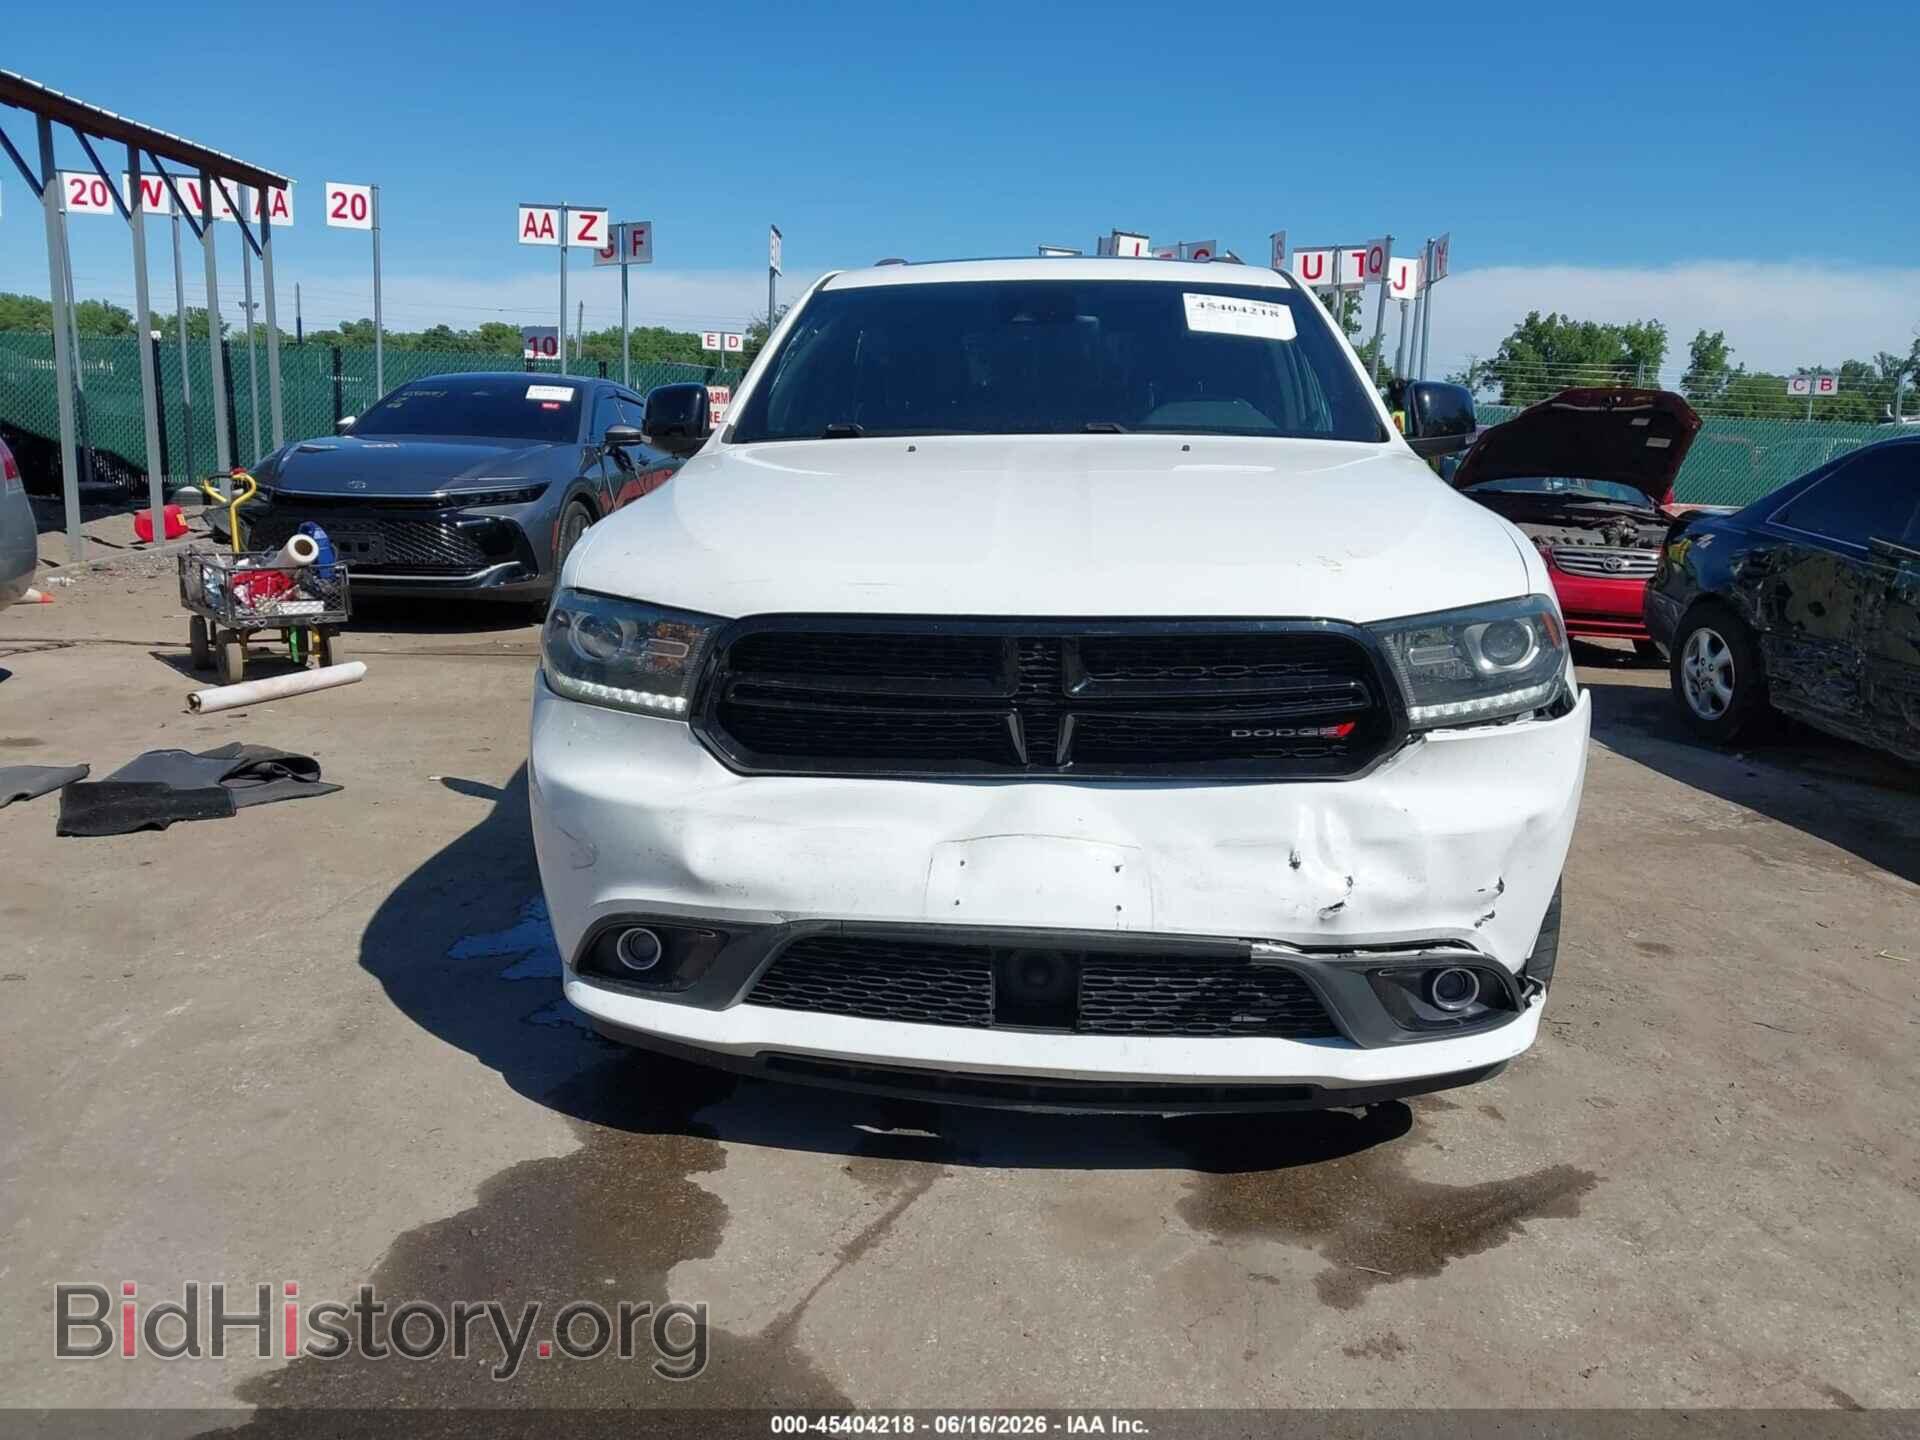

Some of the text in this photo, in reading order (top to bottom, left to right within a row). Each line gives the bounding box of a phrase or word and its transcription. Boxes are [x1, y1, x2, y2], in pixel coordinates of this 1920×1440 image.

[69, 179, 108, 207] 20
[331, 191, 367, 221] 20
[523, 211, 598, 241] AA Z
[632, 229, 645, 256] F
[1302, 252, 1366, 280] U T
[1369, 246, 1383, 274] Q
[1393, 266, 1406, 291] J
[527, 336, 559, 359] 10
[706, 334, 739, 348] E D
[1793, 378, 1832, 391] C B
[1231, 727, 1339, 738] DODGE
